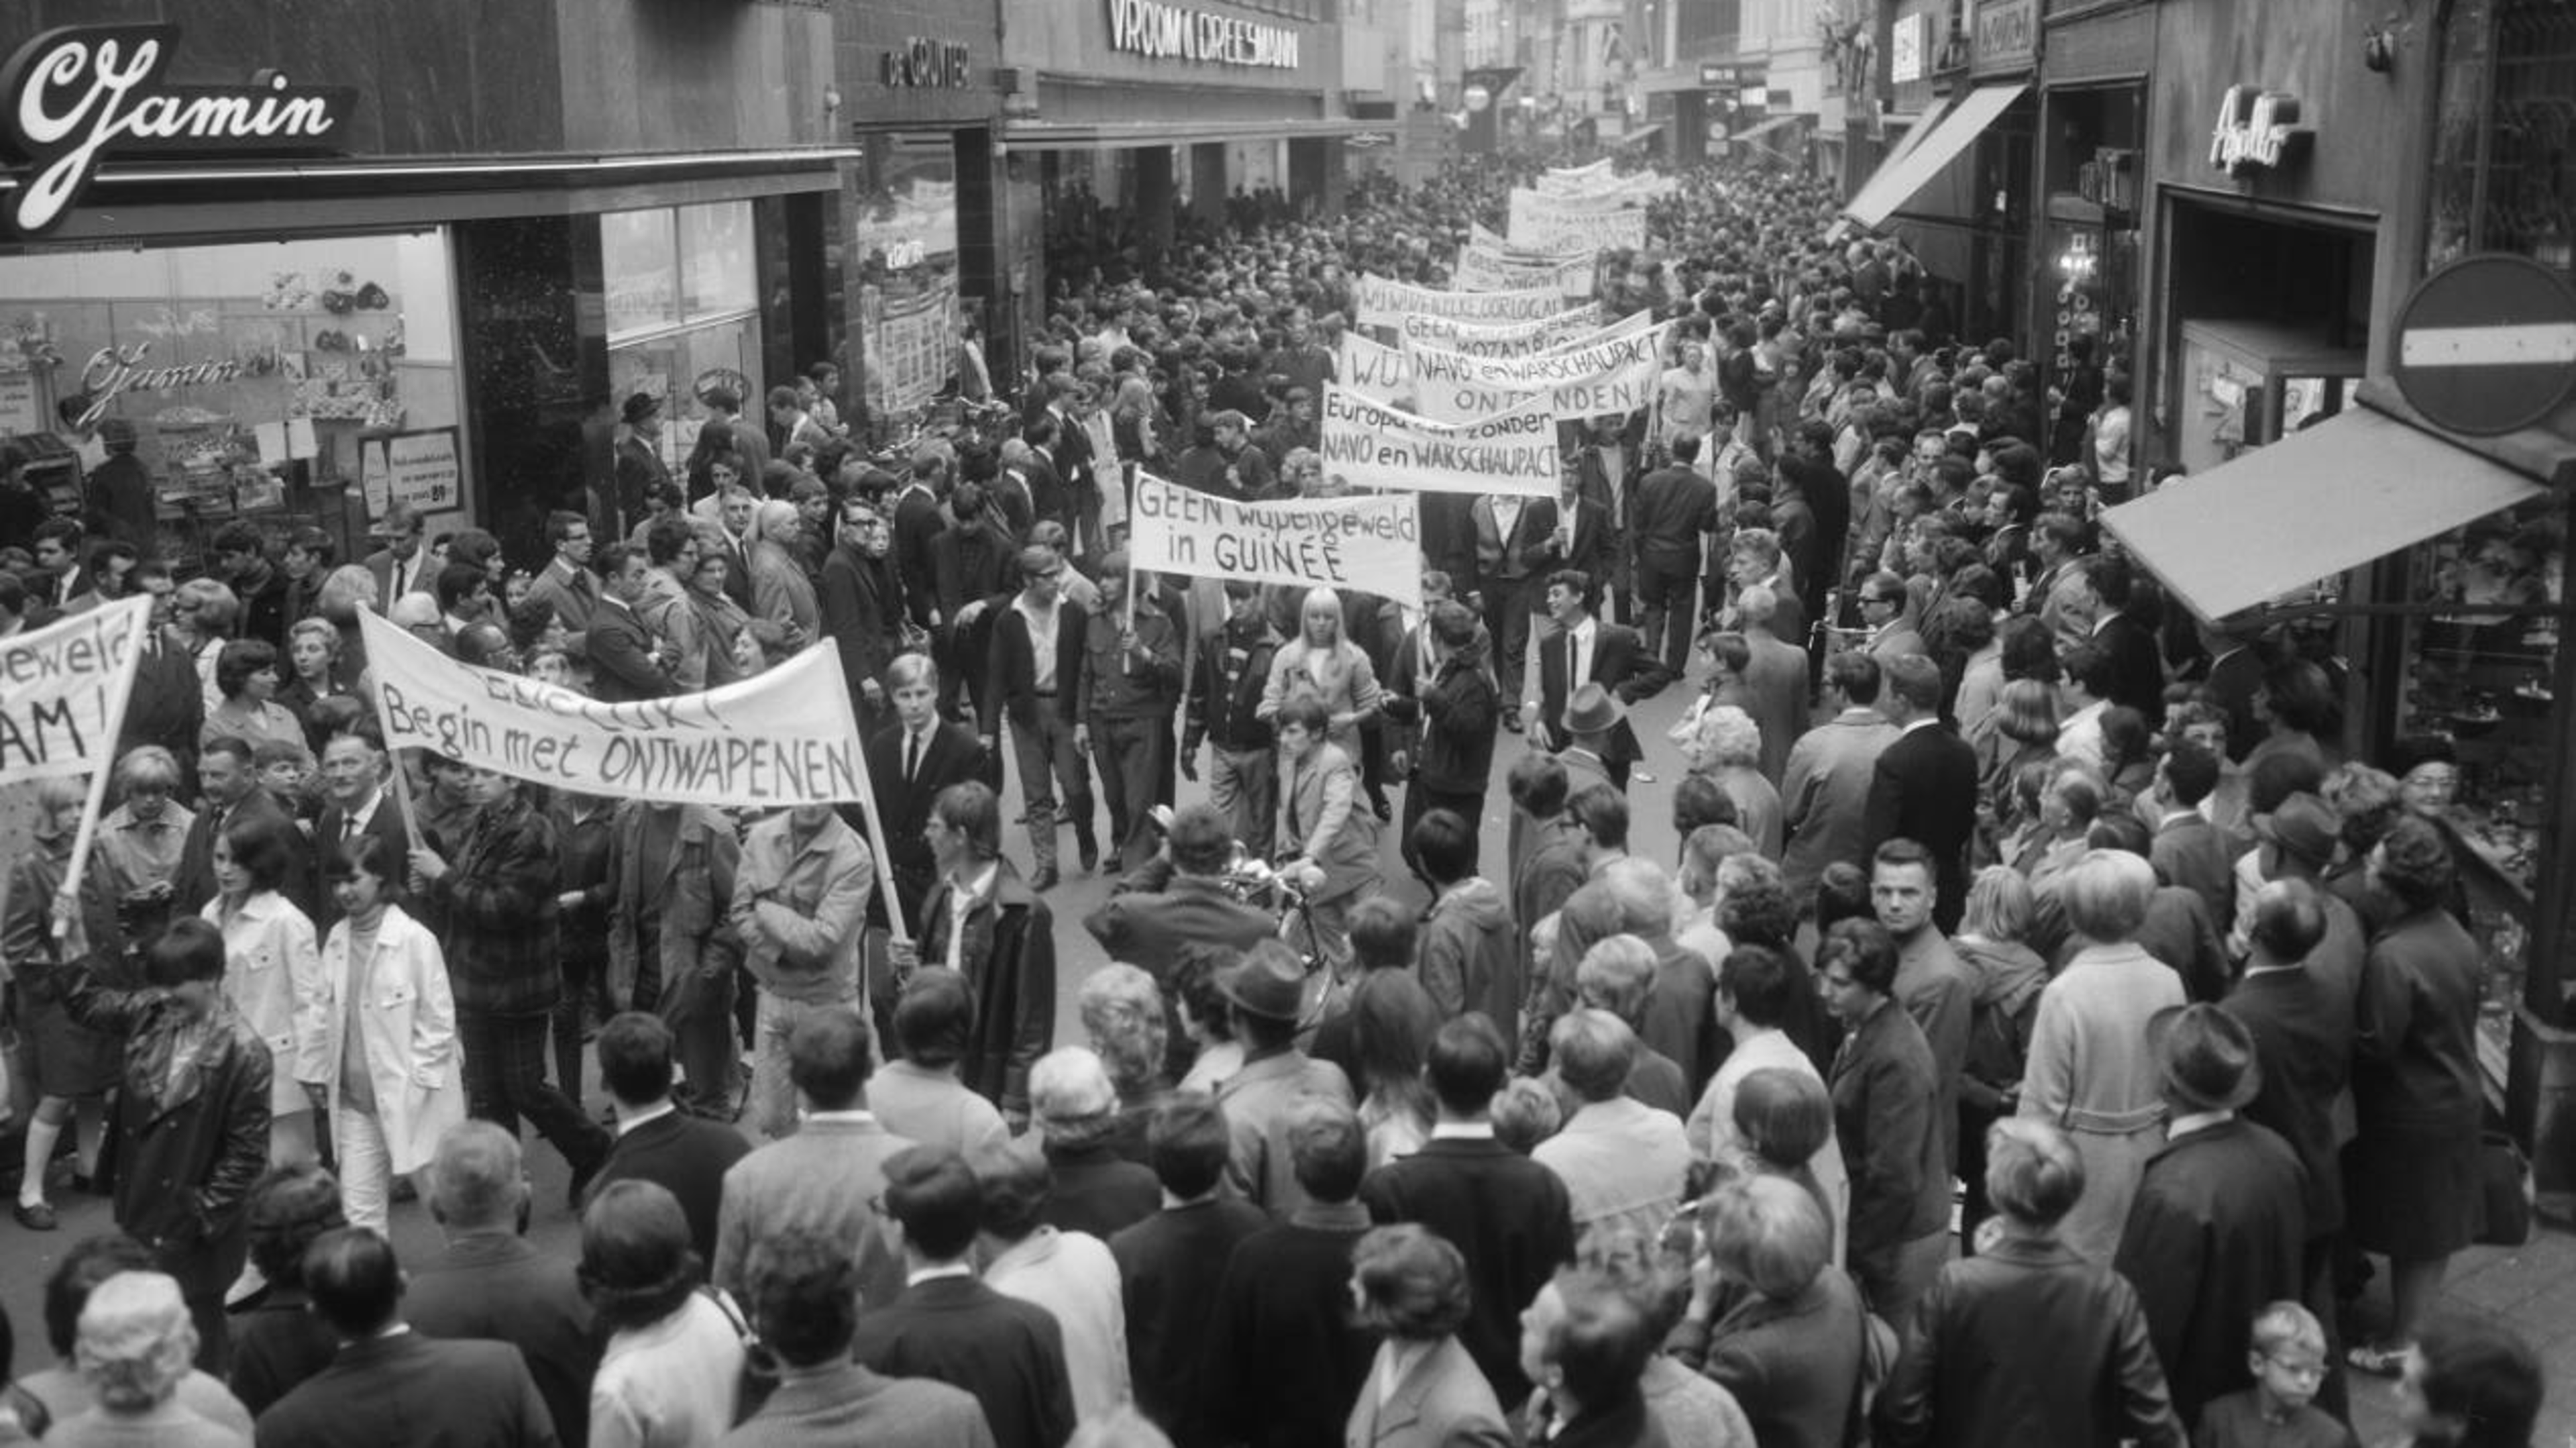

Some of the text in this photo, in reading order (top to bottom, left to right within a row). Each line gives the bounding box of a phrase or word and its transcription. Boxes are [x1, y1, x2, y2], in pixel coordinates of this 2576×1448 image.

[1110, 0, 1181, 56] VROOM
[1197, 13, 1298, 68] DREESMANN
[17, 39, 334, 229] Jamin
[1415, 352, 1472, 382] NAVO
[1481, 363, 1509, 380] en
[1510, 333, 1662, 380] WARSCHAUPACT
[1324, 433, 1558, 478] NAVO en WARSCHAUPACT
[1137, 478, 1222, 525] GEEN
[1168, 525, 1201, 564] in
[0, 609, 132, 683] eweld
[383, 682, 861, 800] Begin met ONTWAPENEN
